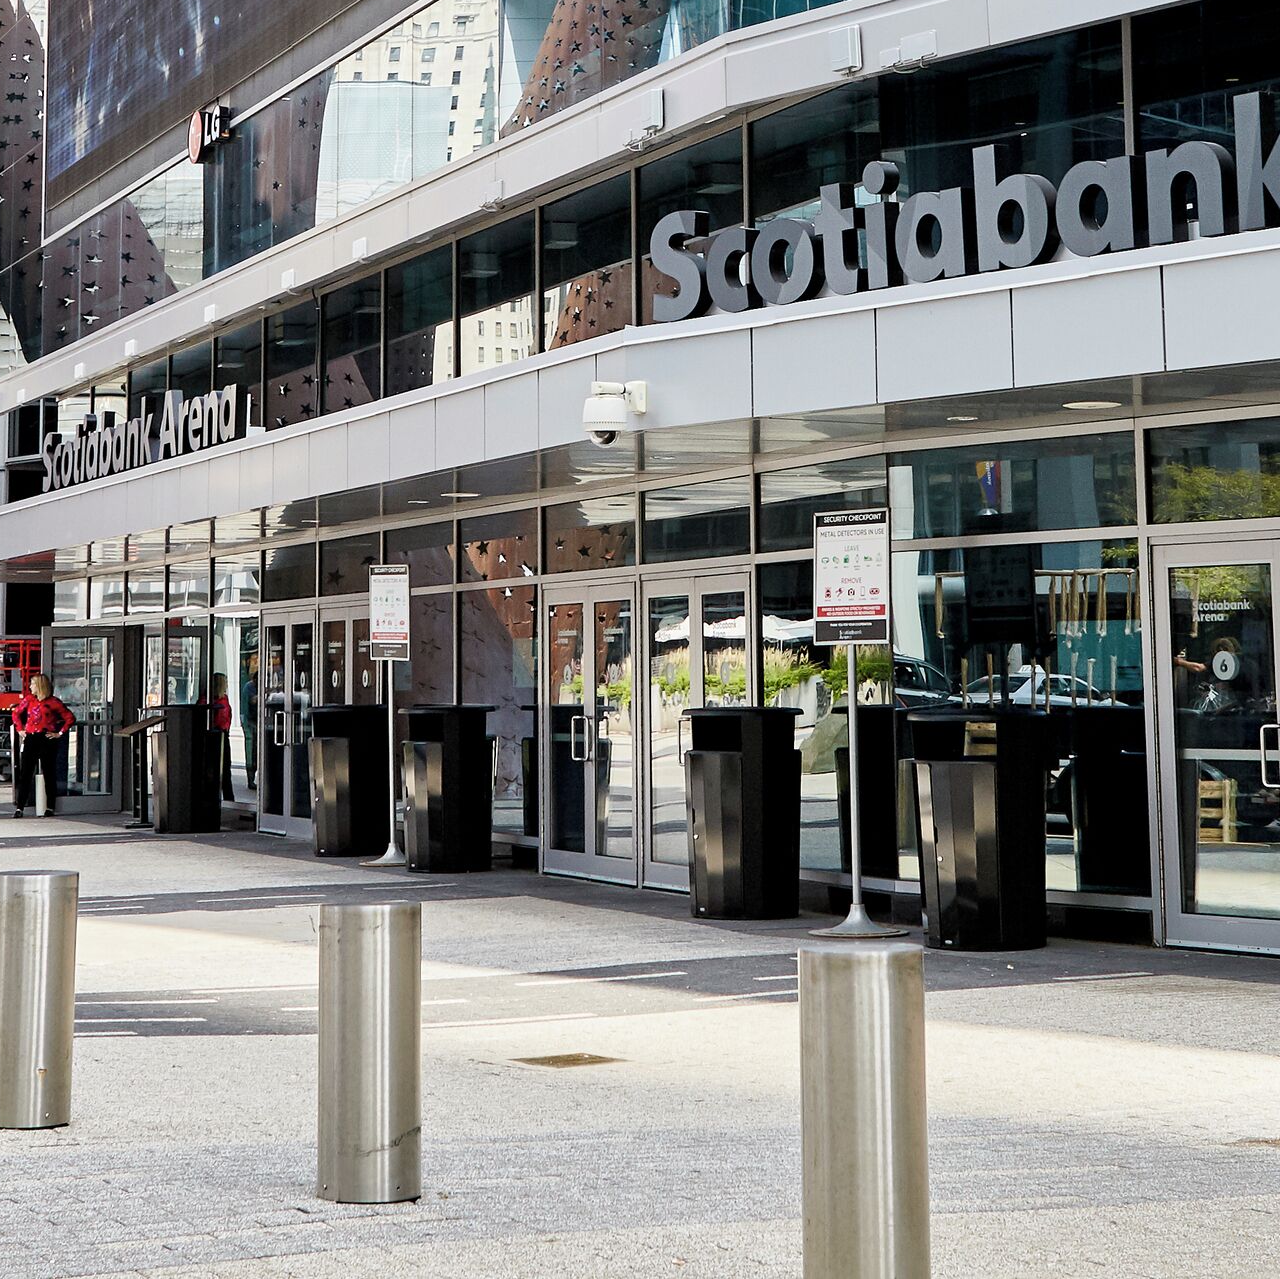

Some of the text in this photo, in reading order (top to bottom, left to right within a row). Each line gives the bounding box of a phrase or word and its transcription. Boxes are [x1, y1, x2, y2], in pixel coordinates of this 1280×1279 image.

[204, 105, 220, 146] LG
[42, 383, 247, 493] Scotiabank Arena
[823, 513, 882, 524] SECURITY CHECKPOINT
[820, 530, 836, 538] METAL
[837, 529, 867, 537] DETECTORS
[1192, 598, 1251, 611] Scotiabank
[1192, 611, 1225, 622] Arena
